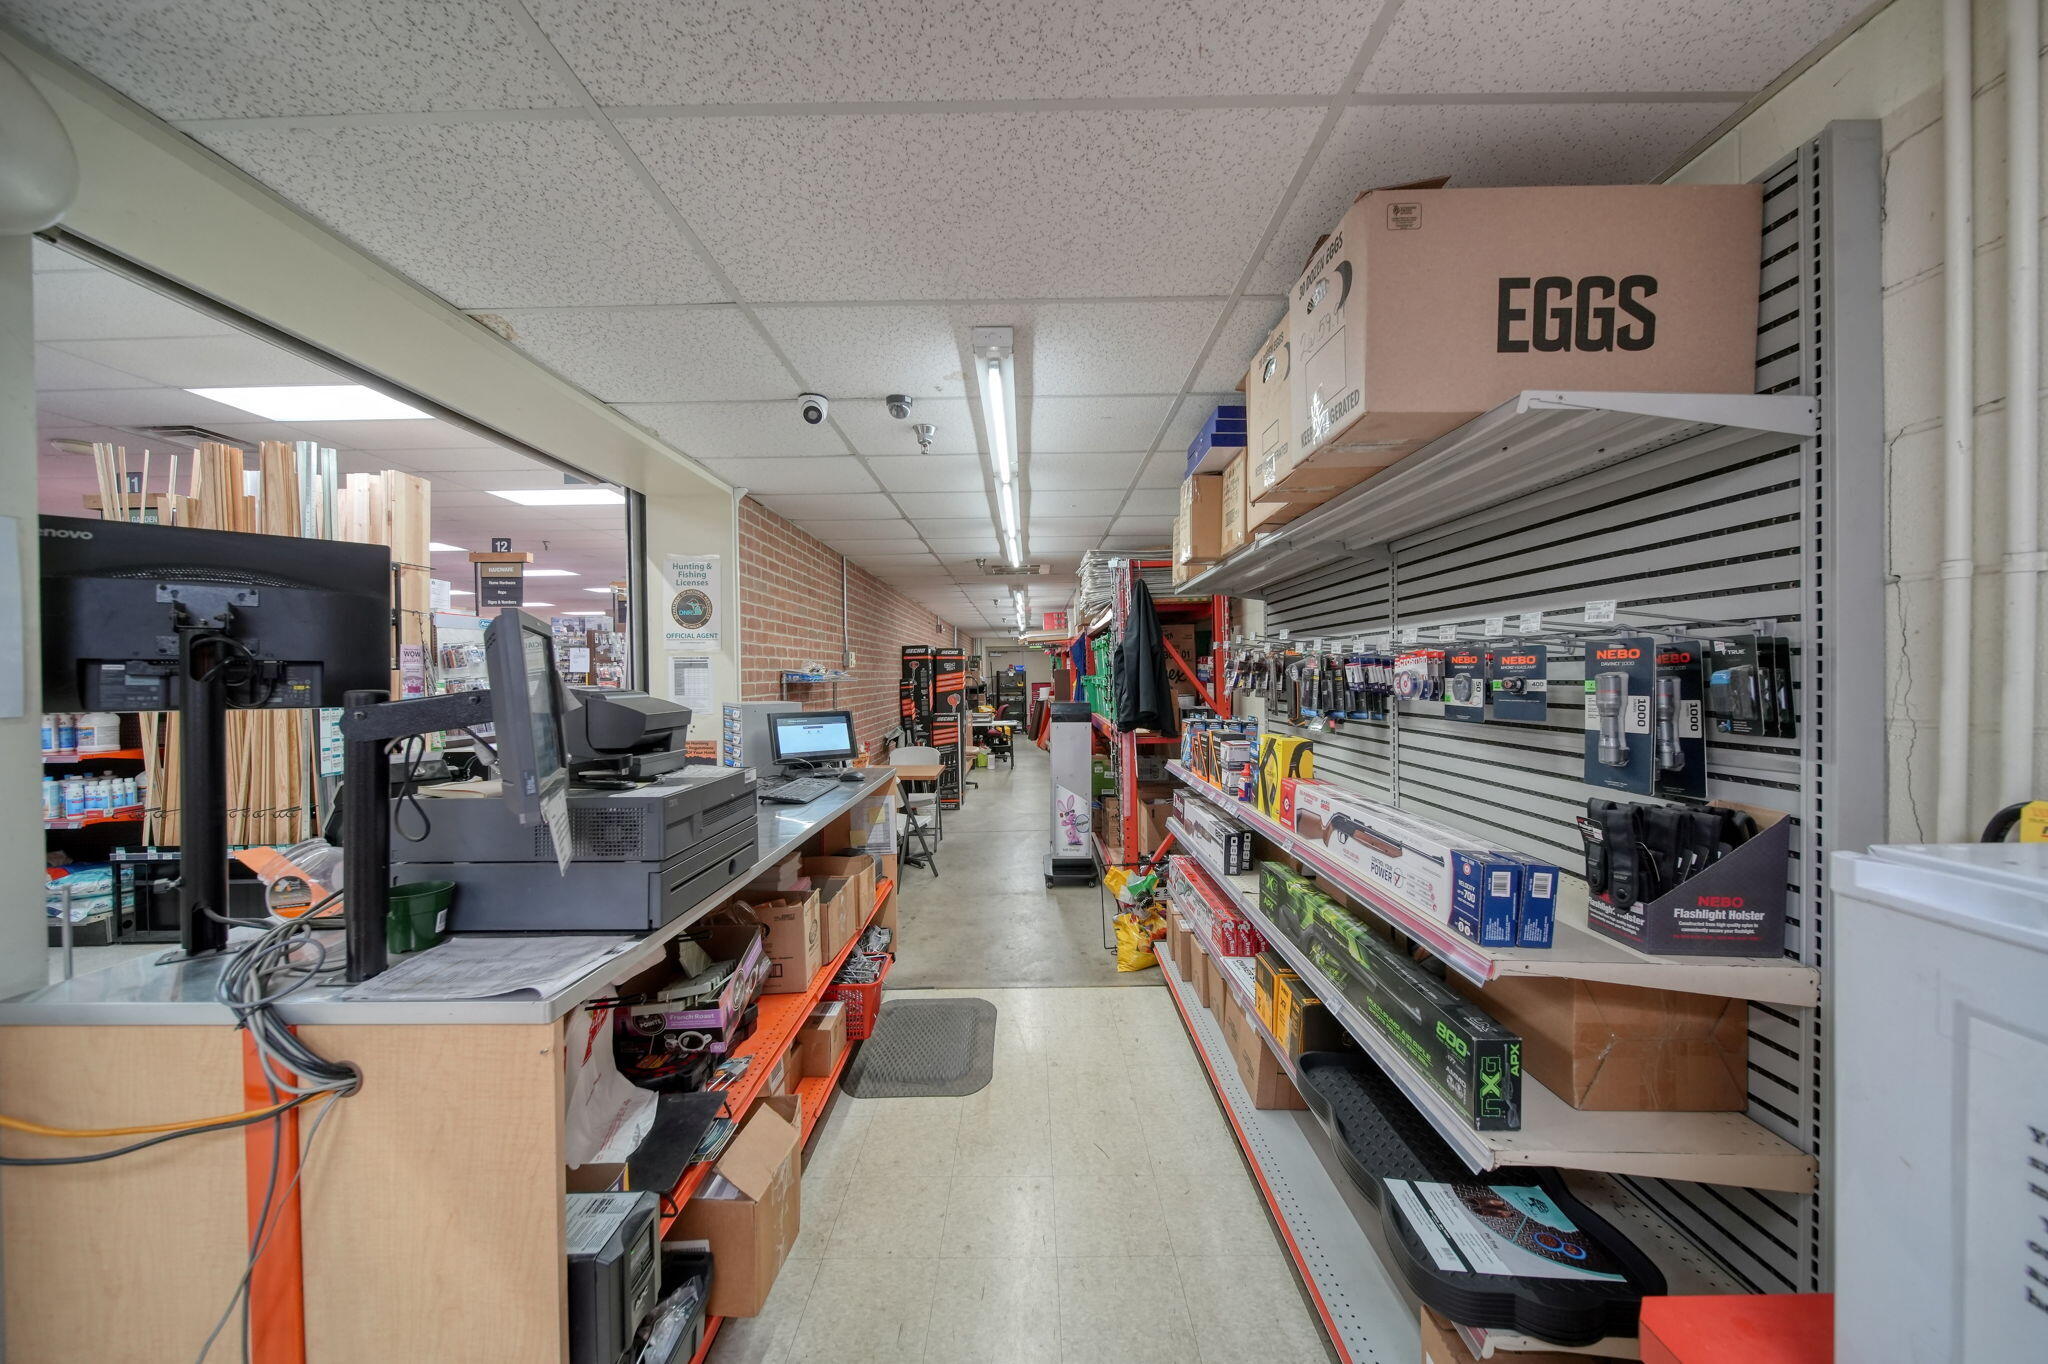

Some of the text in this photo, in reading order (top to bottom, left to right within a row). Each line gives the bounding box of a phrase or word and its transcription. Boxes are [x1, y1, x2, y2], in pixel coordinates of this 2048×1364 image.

[1305, 256, 1325, 291] DOZEN
[1325, 231, 1343, 264] EGGS
[1497, 275, 1657, 353] EGGS
[496, 541, 508, 552] 12
[672, 563, 704, 571] Hunting
[678, 571, 707, 579] Fishing
[1451, 655, 1478, 664] NEBO
[1501, 655, 1536, 665] NEBO
[1596, 648, 1641, 660] NEBO
[1656, 652, 1690, 664] NEBO
[1476, 681, 1481, 693] 50
[1637, 698, 1646, 728] 1000
[1689, 702, 1699, 732] 1000
[1371, 862, 1393, 883] POWER
[1458, 879, 1476, 891] VELOCITY
[1463, 889, 1476, 903] 700
[1697, 896, 1744, 908] NEBO
[1673, 908, 1765, 921] Flashlight Holster
[1435, 1021, 1468, 1058] 800
[1510, 1043, 1520, 1077] APX
